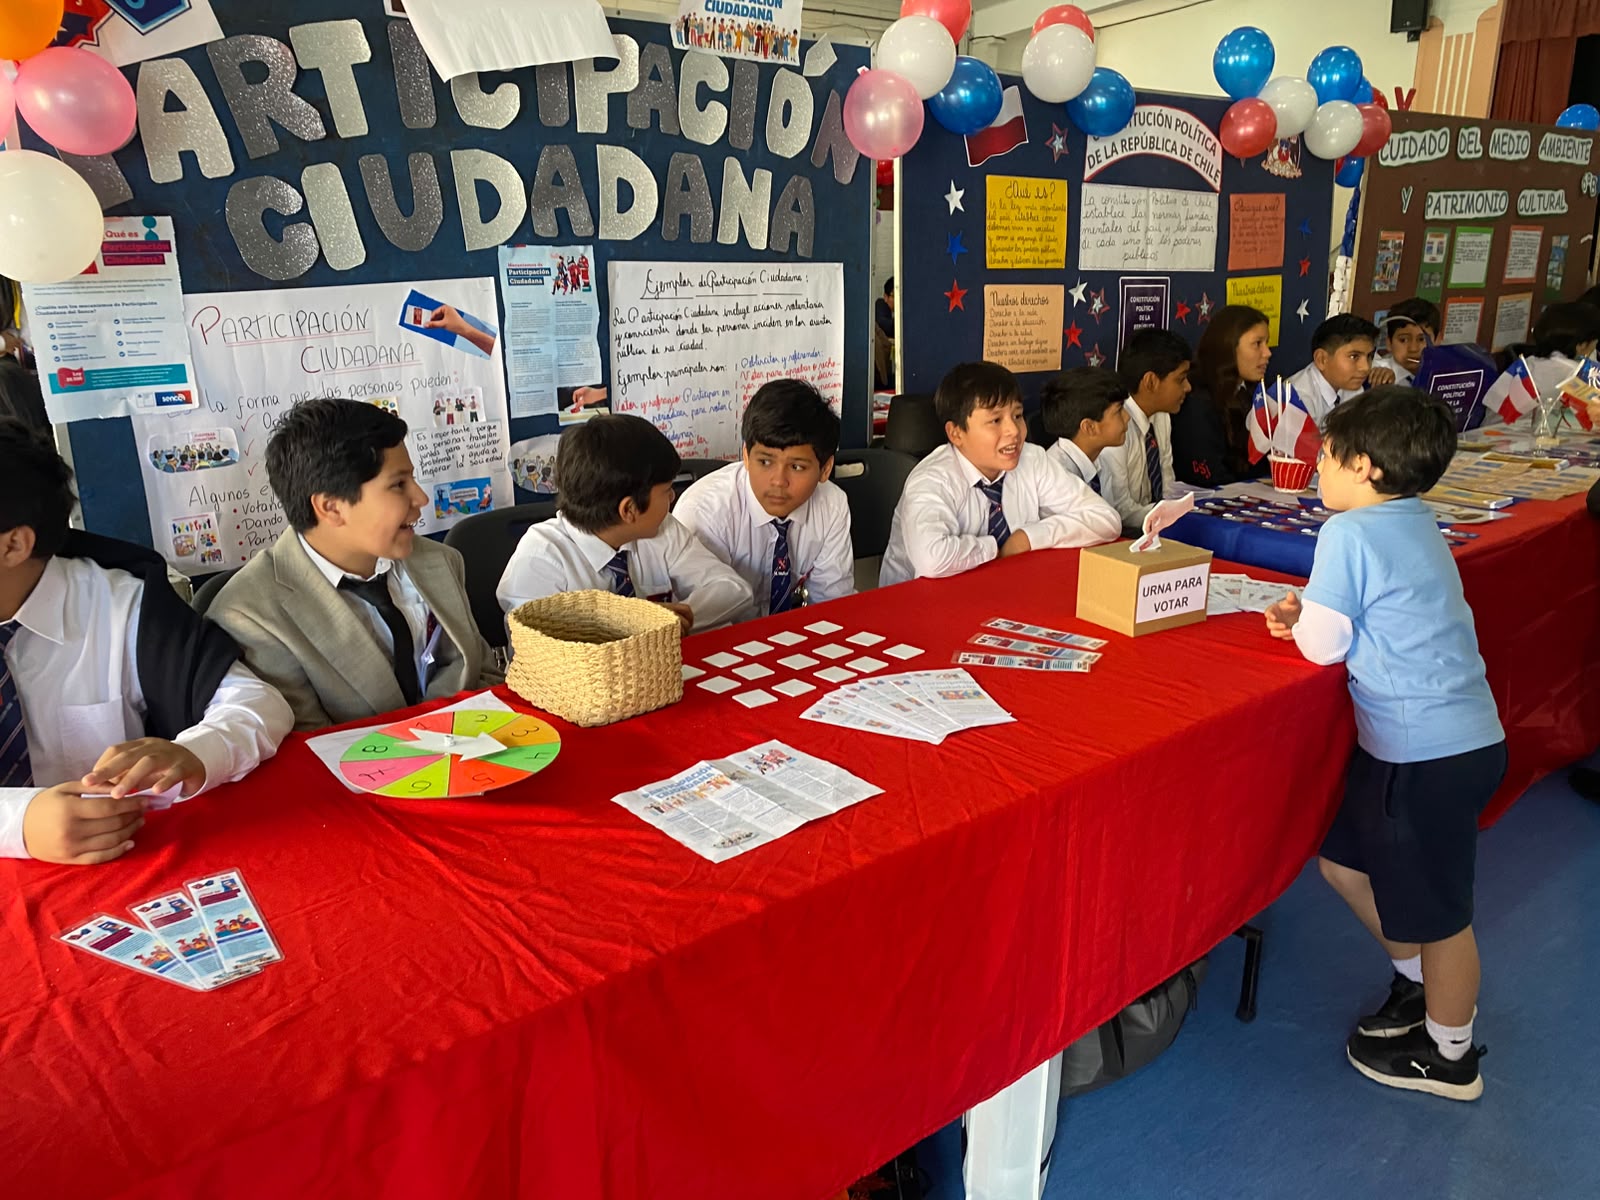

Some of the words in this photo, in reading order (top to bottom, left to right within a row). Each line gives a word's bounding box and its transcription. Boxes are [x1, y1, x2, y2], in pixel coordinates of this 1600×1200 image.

[704, 0, 773, 22] CIUDADANA
[55, 19, 862, 208] ARTICIPACIÓN
[1175, 118, 1217, 157] POLÍTICA
[1380, 130, 1448, 161] CUIDADO
[1459, 131, 1481, 154] DEL
[1491, 131, 1530, 155] MEDIO
[1540, 134, 1592, 161] AMBIENTE
[1087, 149, 1103, 169] DE
[1104, 141, 1118, 159] LA
[1120, 131, 1177, 155] REPÚBLICA
[1180, 144, 1193, 161] DE
[1194, 153, 1220, 183] CHILE
[225, 144, 816, 281] CIUDADANA
[1402, 187, 1413, 212] Y
[1426, 192, 1508, 216] PATRIMONIO
[1518, 190, 1566, 213] CULTURAL
[509, 268, 550, 276] Participación
[612, 307, 626, 327] La
[1136, 304, 1154, 312] POLÍTICA
[301, 342, 415, 374] CIUDADANA
[348, 380, 403, 400] personas
[433, 437, 465, 452] personas
[188, 484, 250, 511] Algunos
[242, 515, 283, 531] Dando
[1143, 583, 1172, 598] URNA
[1175, 576, 1202, 591] PARA
[1154, 597, 1189, 613] VOTAR
[512, 727, 539, 738] 3
[362, 745, 388, 754] 8
